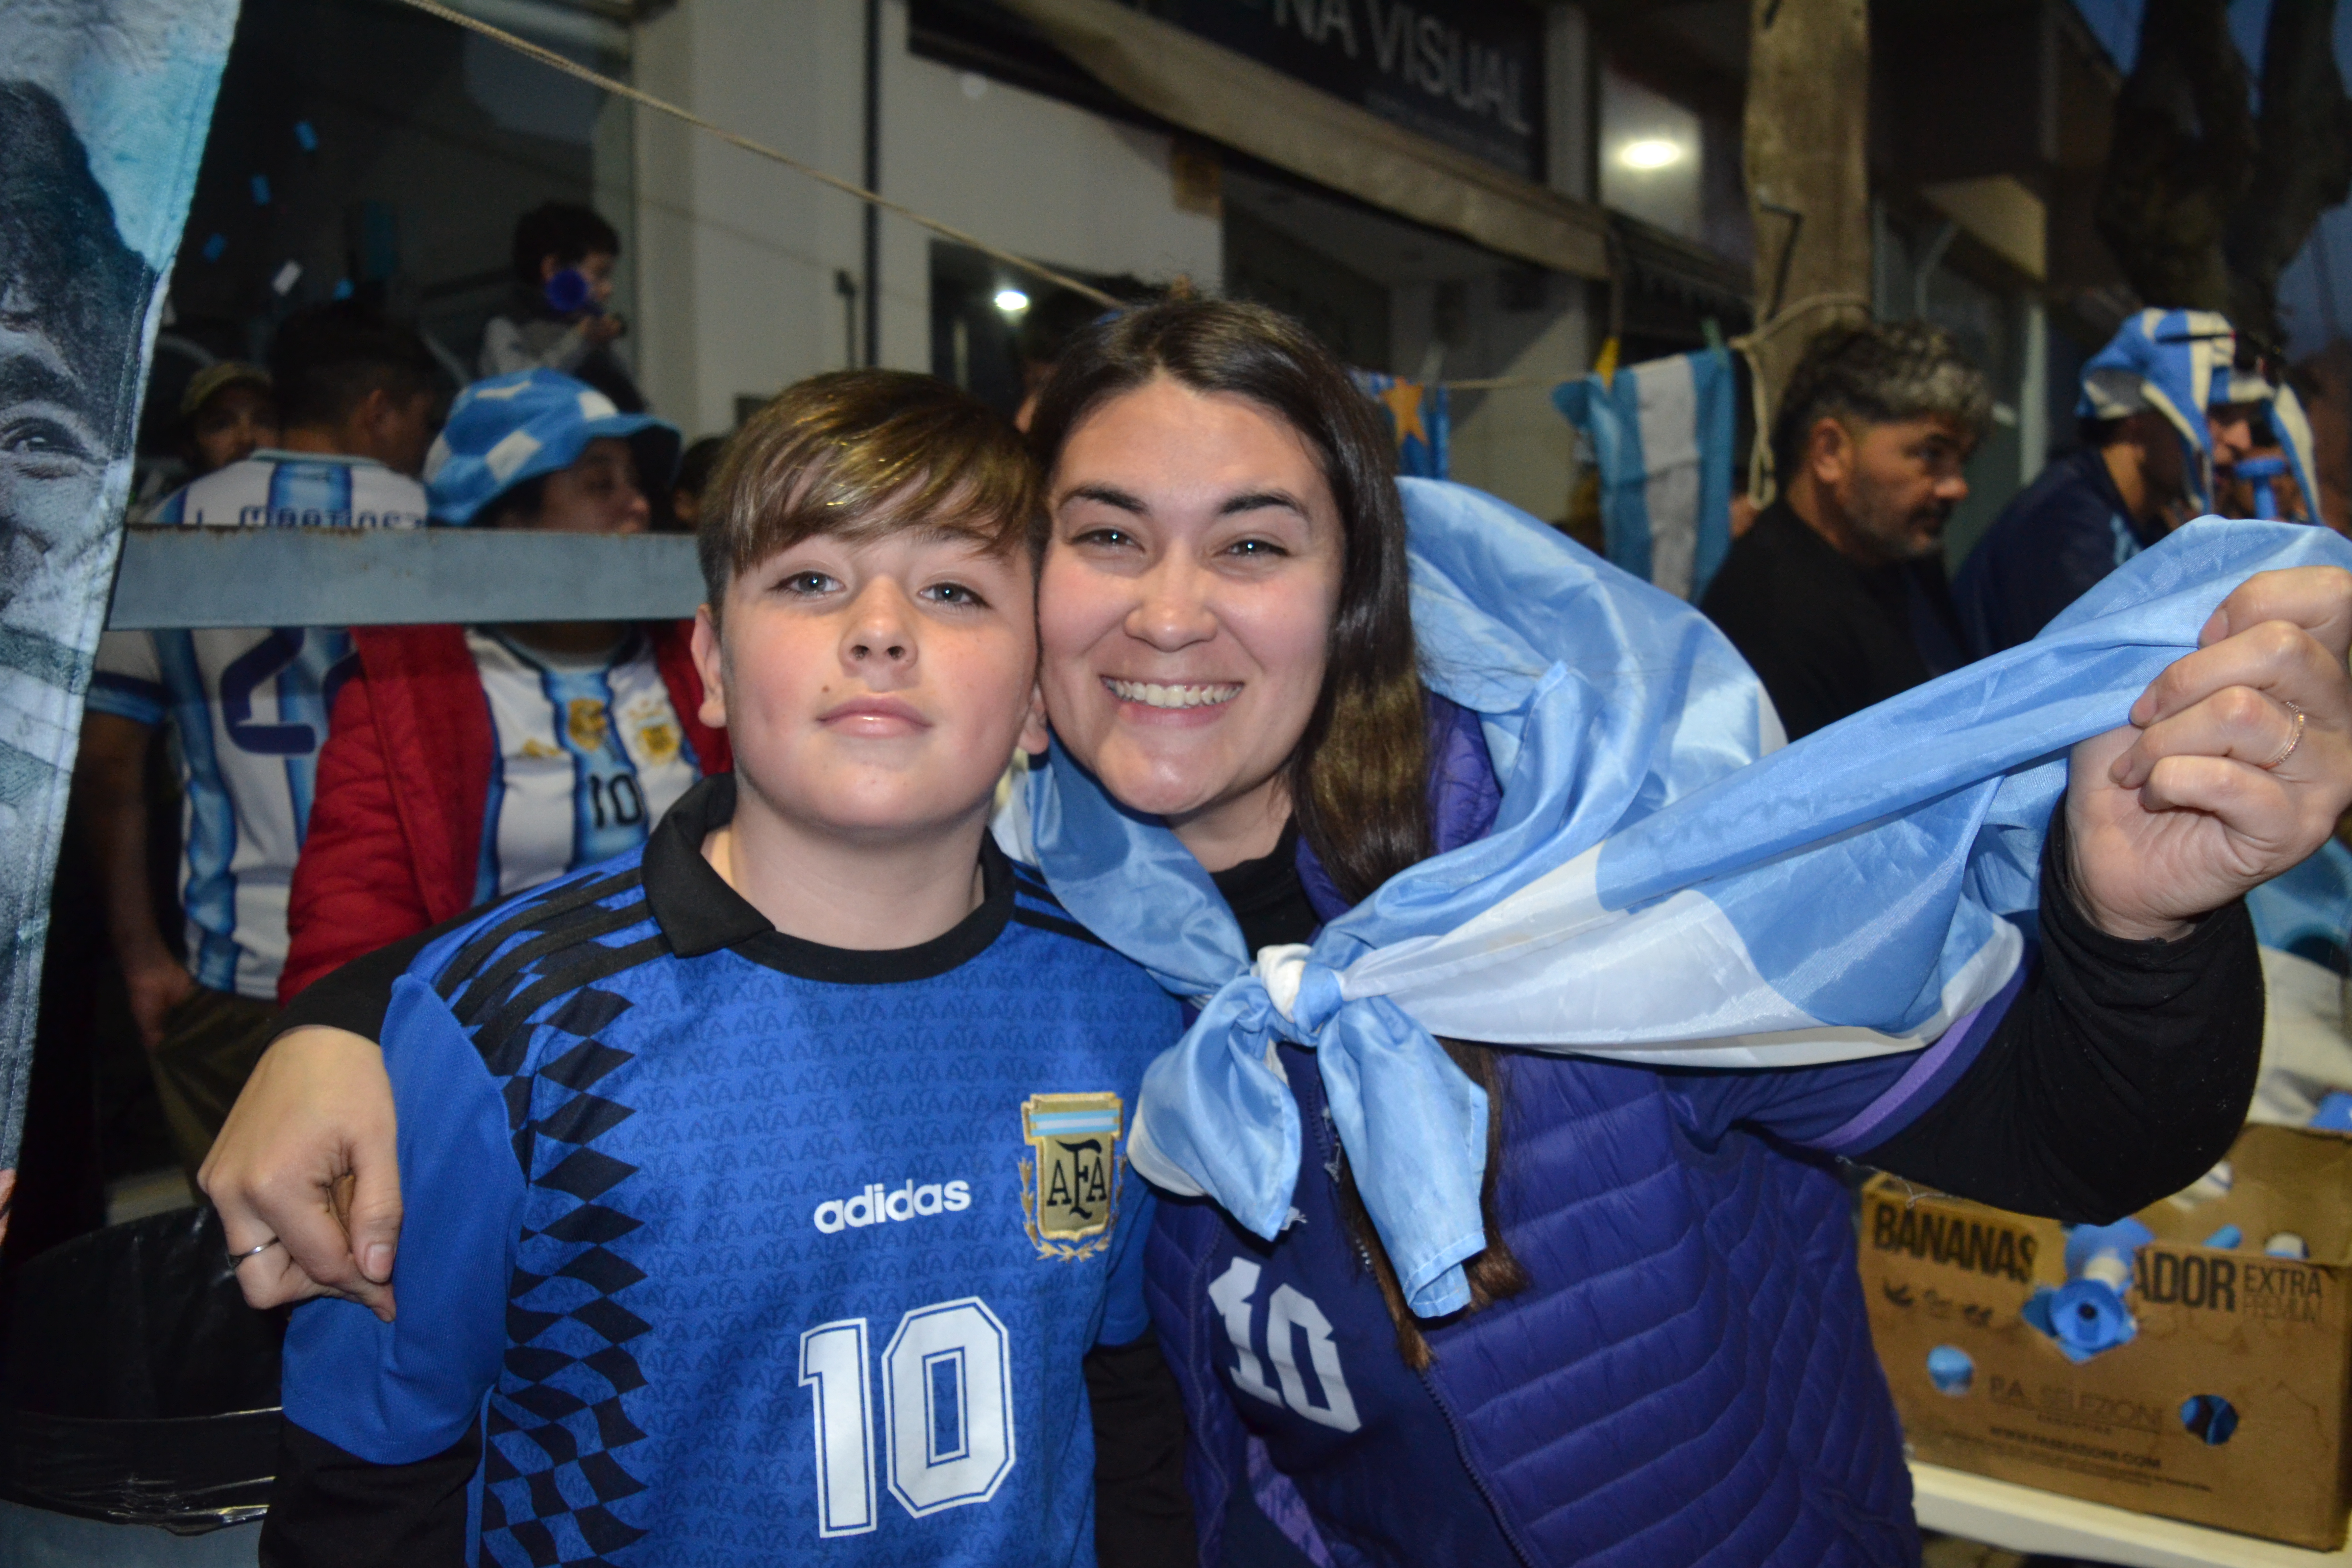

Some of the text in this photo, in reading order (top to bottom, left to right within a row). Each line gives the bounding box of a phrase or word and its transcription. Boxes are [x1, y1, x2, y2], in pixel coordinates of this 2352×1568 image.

[1365, 0, 1531, 136] VISUAL
[587, 772, 643, 829] 10
[814, 1179, 971, 1234] adidas
[1047, 1139, 1107, 1220] AFA
[1873, 1201, 2039, 1285] BANANAS
[2243, 1263, 2322, 1299] EXTRA
[1208, 1256, 1362, 1433] 10
[798, 1295, 1016, 1538] 10
